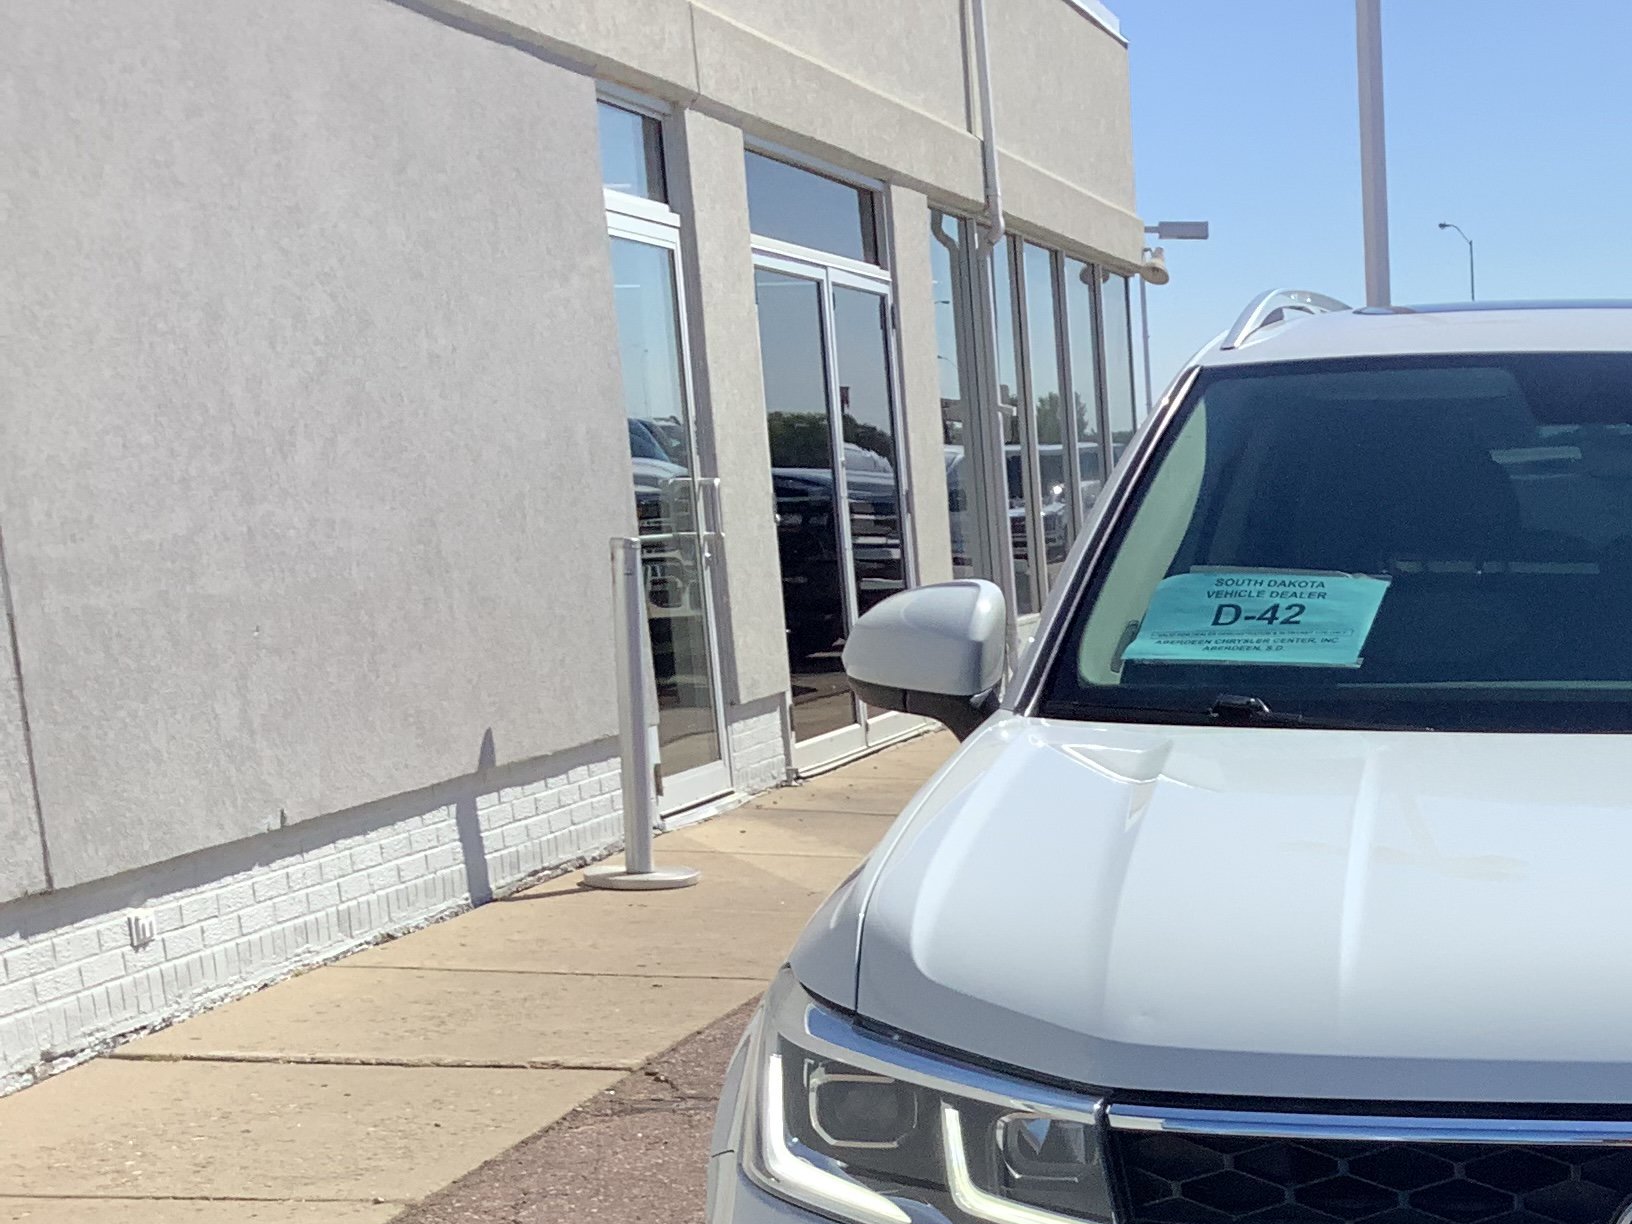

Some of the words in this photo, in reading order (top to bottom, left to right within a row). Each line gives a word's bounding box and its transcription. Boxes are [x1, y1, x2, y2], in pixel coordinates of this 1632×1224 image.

[1214, 578, 1263, 587] SOUTH
[1267, 579, 1325, 588] DAKOTA
[1206, 590, 1266, 599] VEHICLE
[1269, 590, 1327, 600] DEALER
[1211, 603, 1306, 626] D-42
[1214, 637, 1271, 645] CHRYSLER
